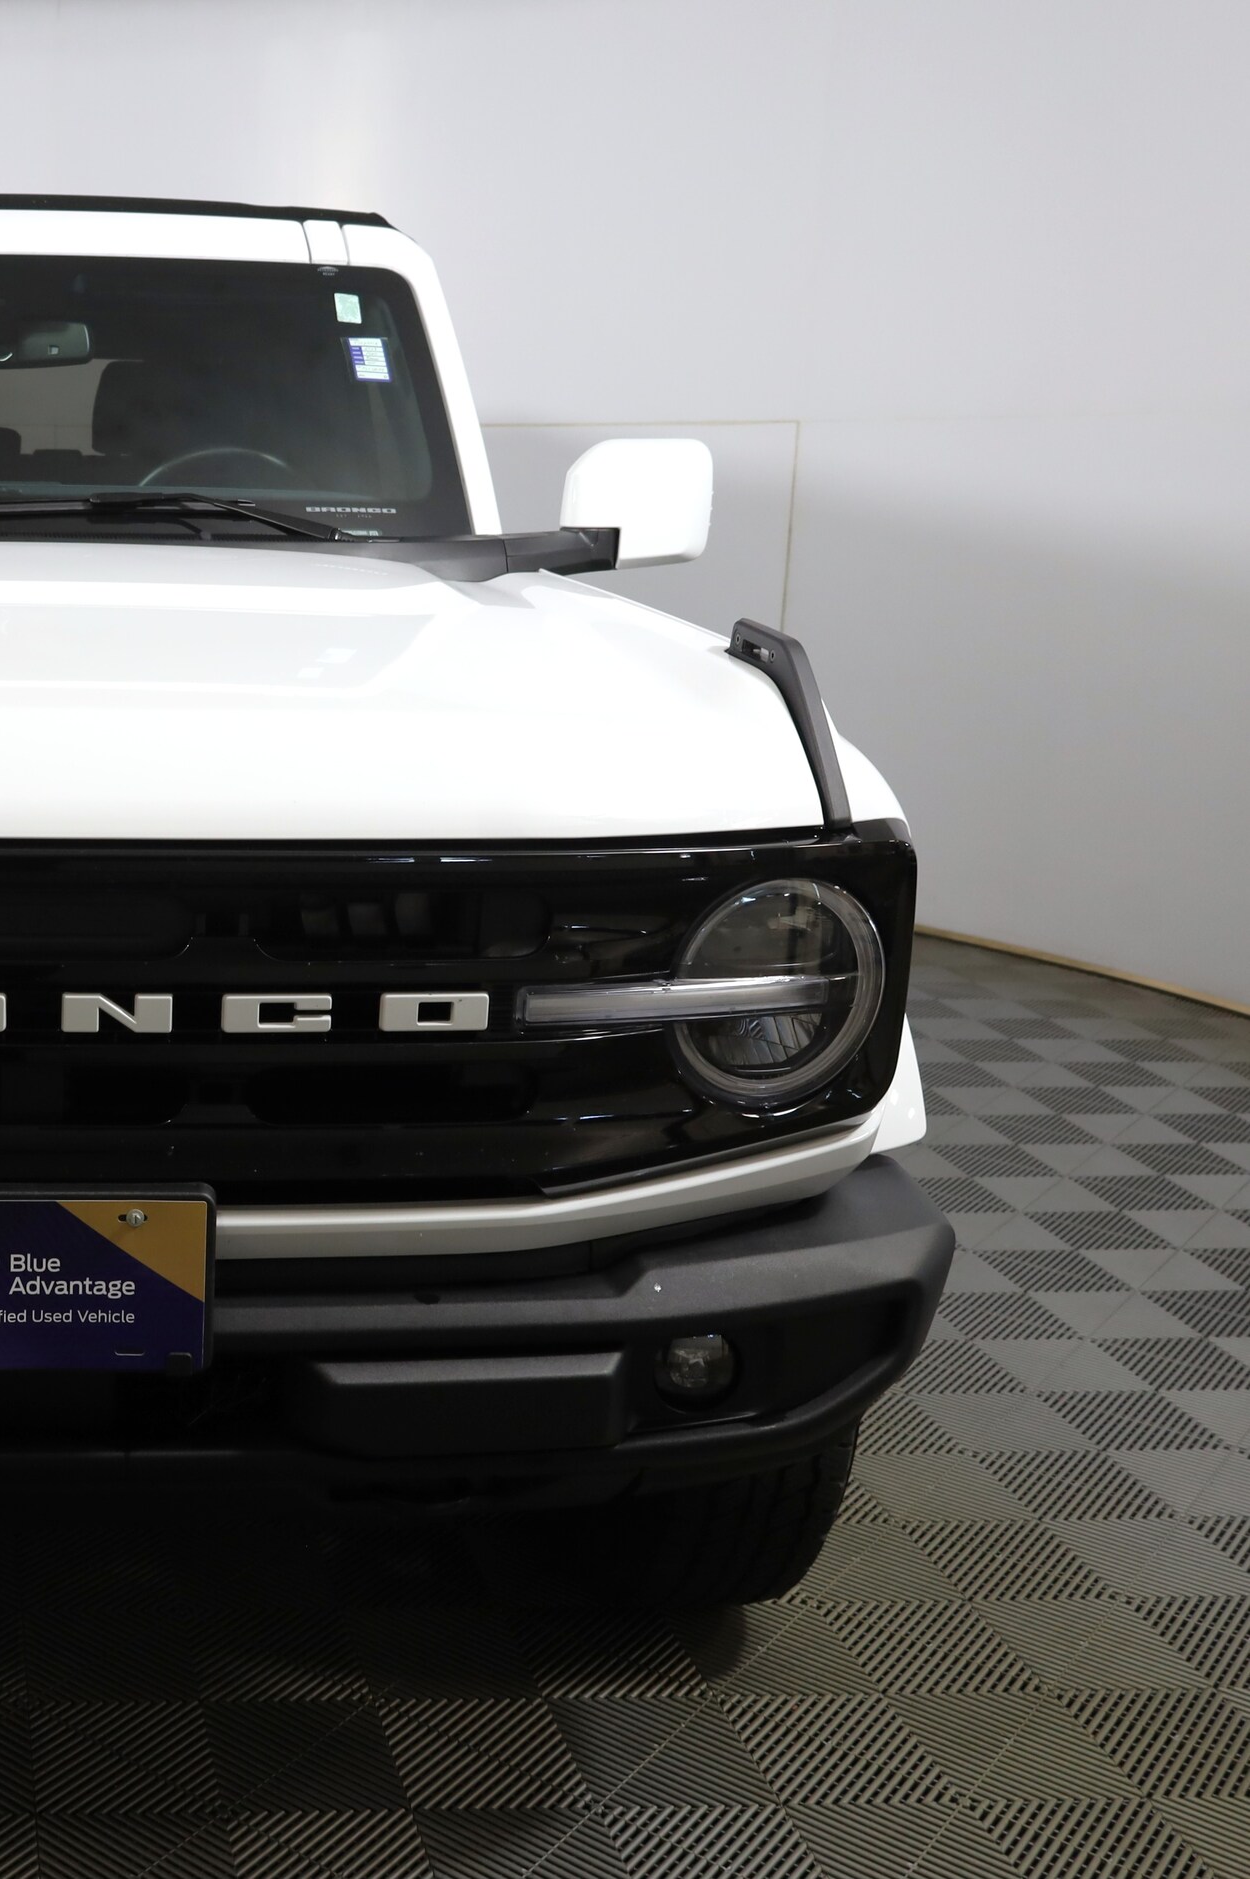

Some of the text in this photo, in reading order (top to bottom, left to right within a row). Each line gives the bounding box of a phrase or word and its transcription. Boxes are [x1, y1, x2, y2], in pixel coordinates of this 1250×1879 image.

[9, 1254, 61, 1273] Blue
[8, 1276, 136, 1299] Advantage
[31, 1309, 73, 1324] Used
[77, 1309, 135, 1324] Vehicle
